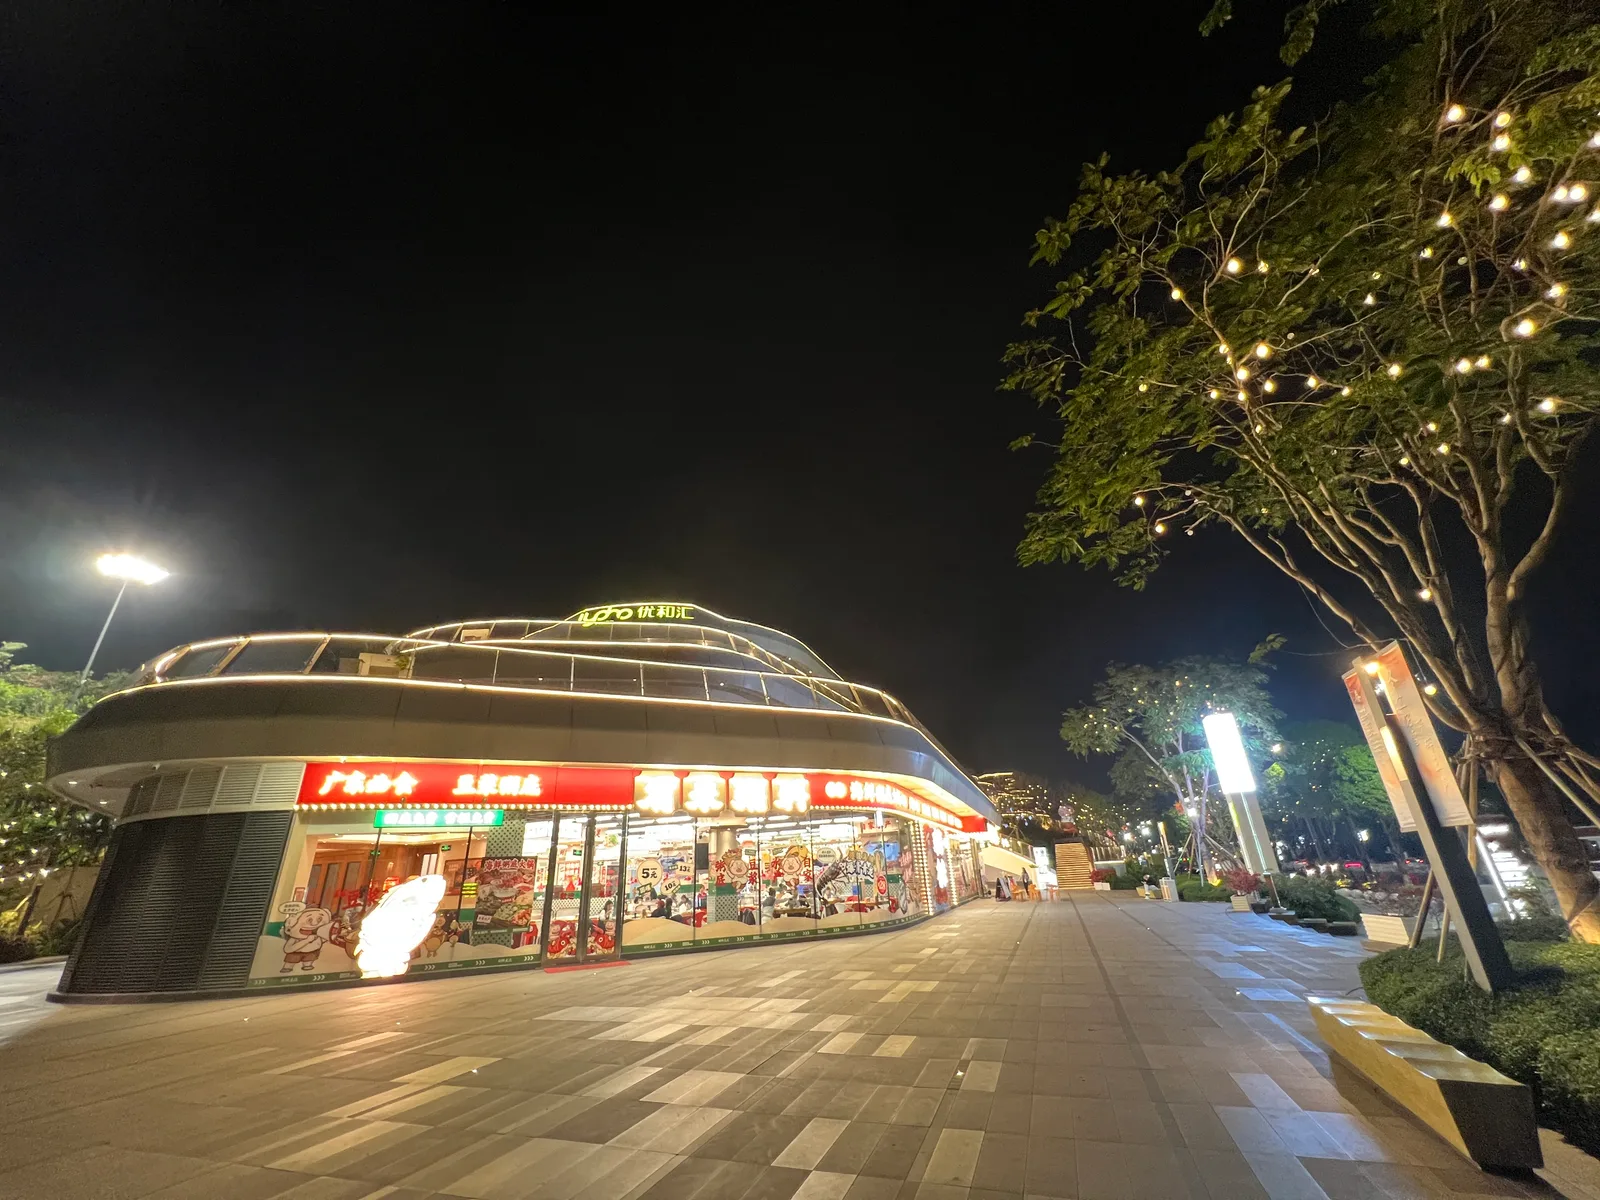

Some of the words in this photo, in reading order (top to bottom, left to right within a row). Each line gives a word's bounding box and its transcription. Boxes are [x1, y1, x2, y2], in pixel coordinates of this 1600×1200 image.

[637, 605, 694, 620] 优和汇
[484, 858, 536, 871] 海鲜粥底火锅
[748, 858, 758, 885] 豆浆
[802, 858, 813, 882] 自家
[641, 867, 658, 879] 5元
